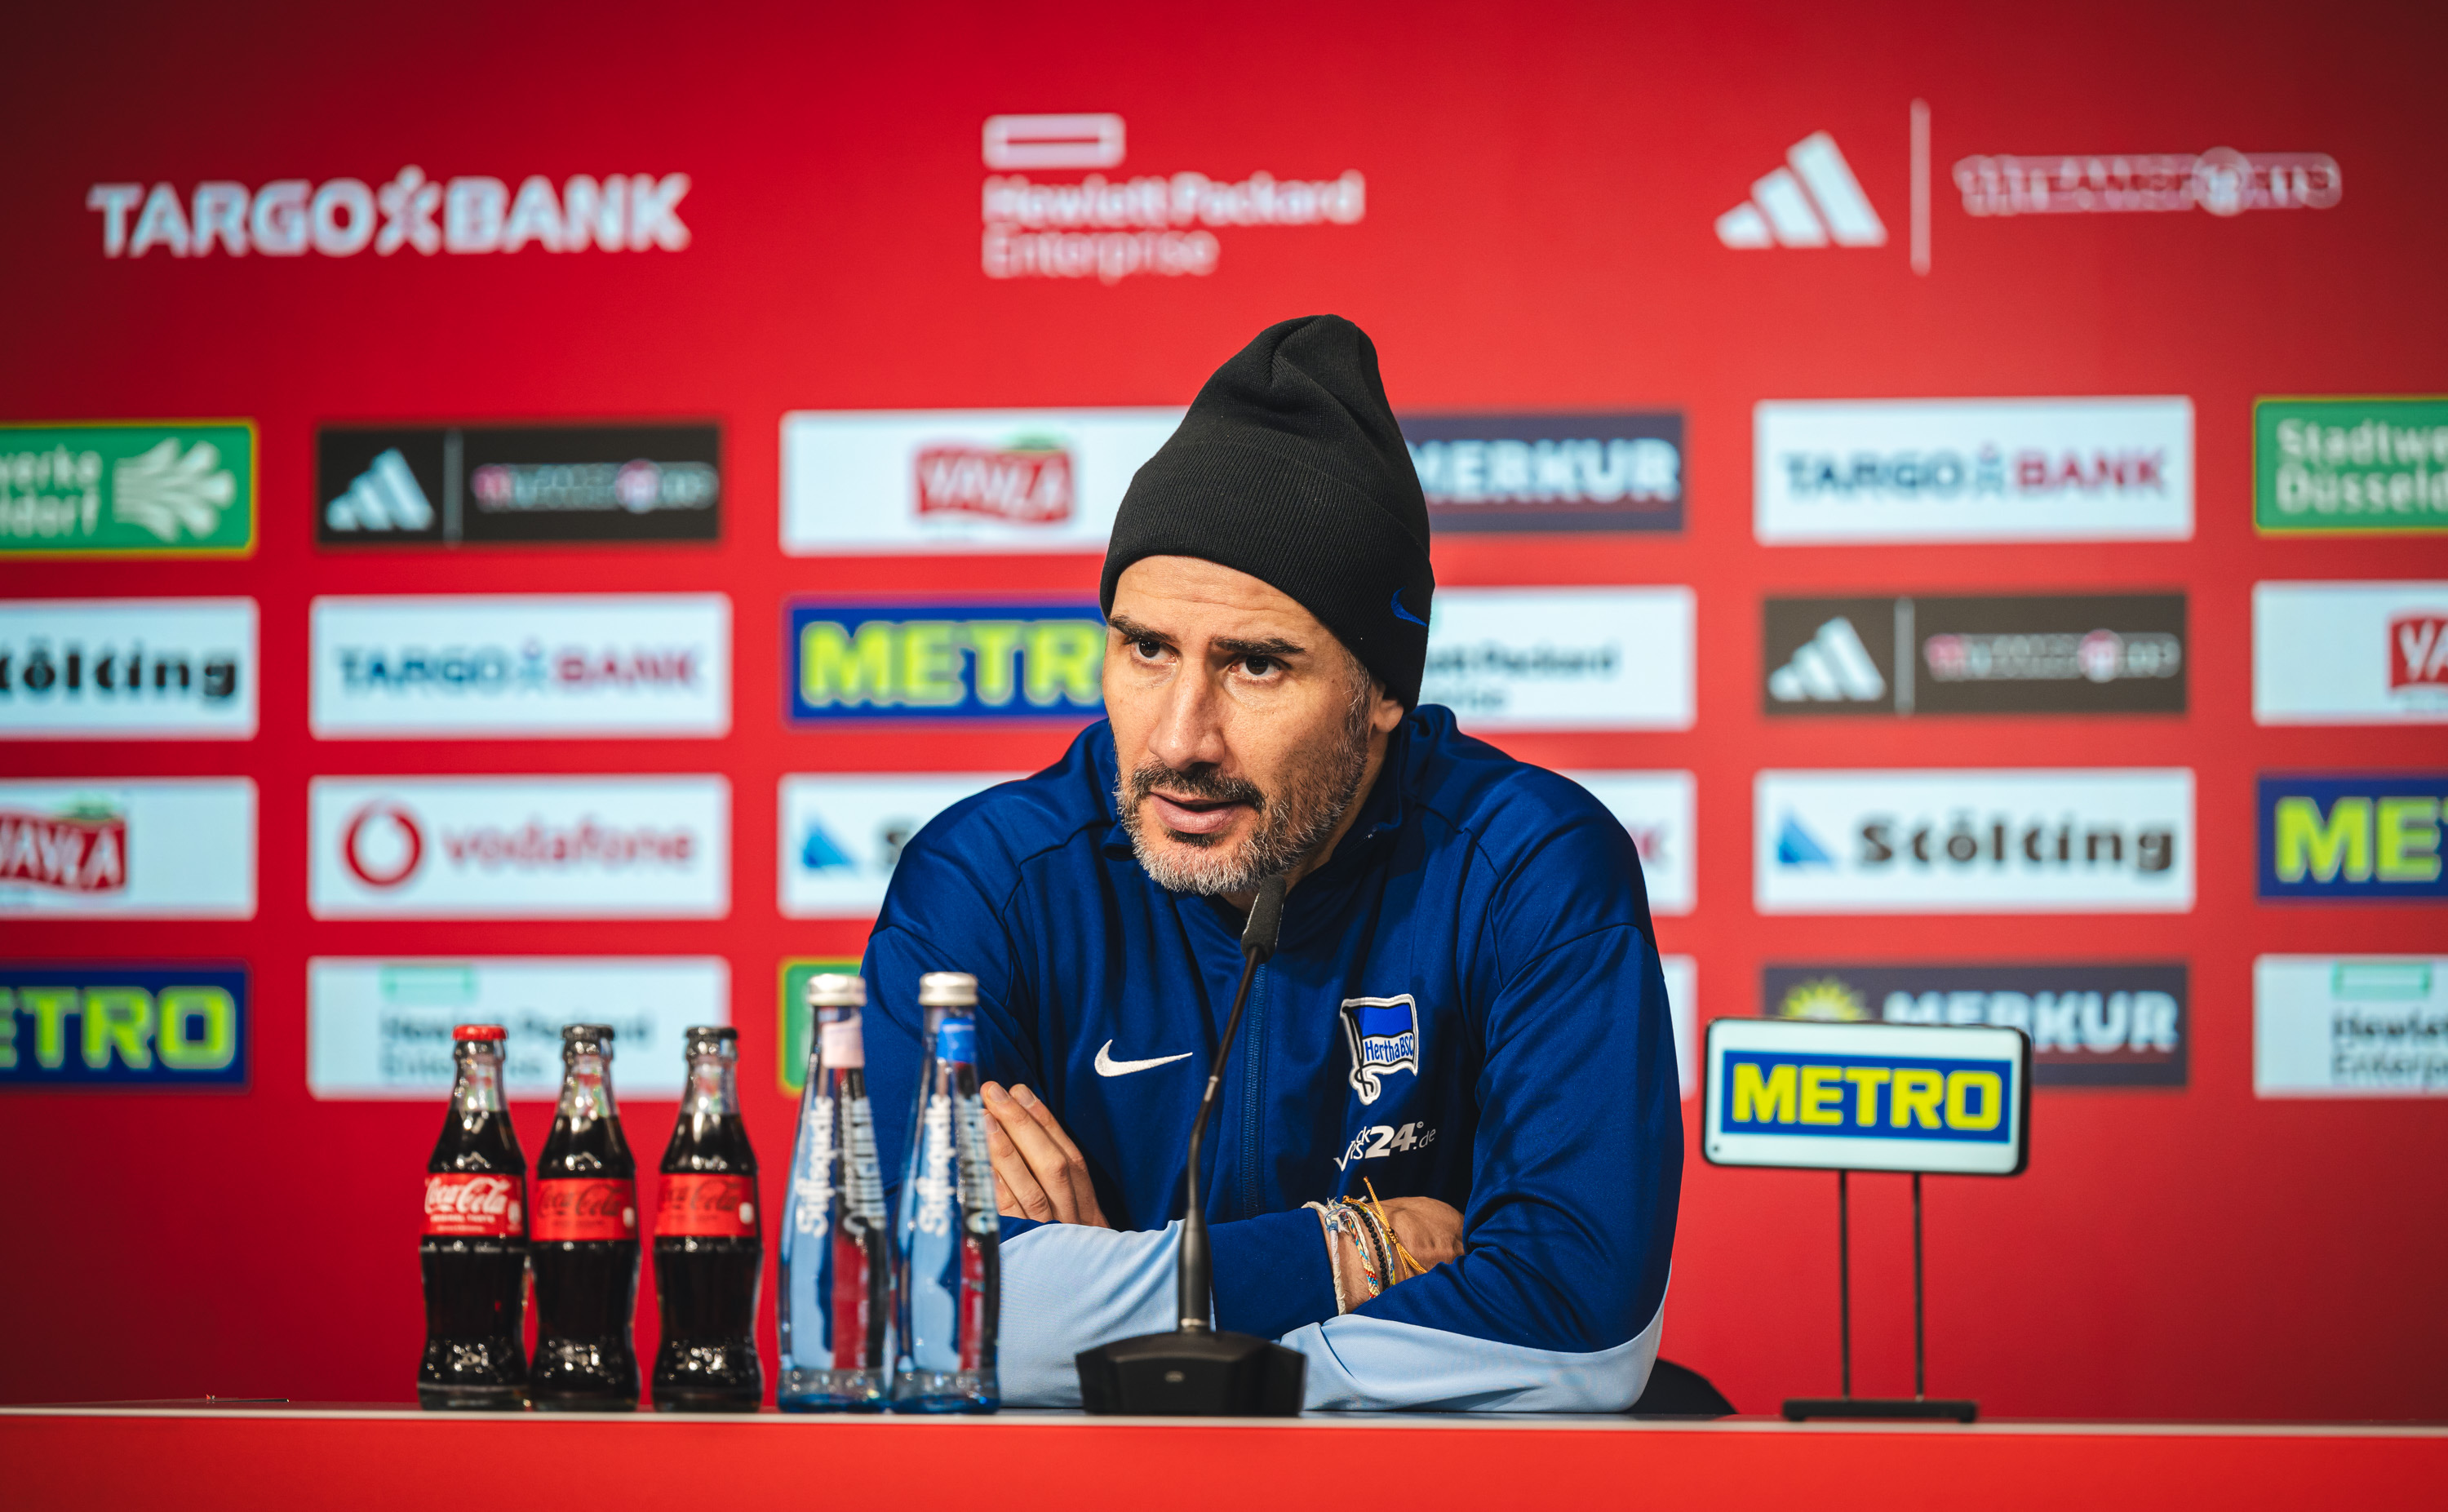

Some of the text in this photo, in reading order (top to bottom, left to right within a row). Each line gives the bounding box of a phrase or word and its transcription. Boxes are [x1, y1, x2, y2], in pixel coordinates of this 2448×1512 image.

[1169, 170, 1365, 227] Packard
[982, 225, 1220, 286] Enterprise
[801, 620, 1107, 707] METR
[2274, 796, 2448, 883] ME
[0, 985, 236, 1070] TRO
[1732, 1063, 2002, 1131] METRO
